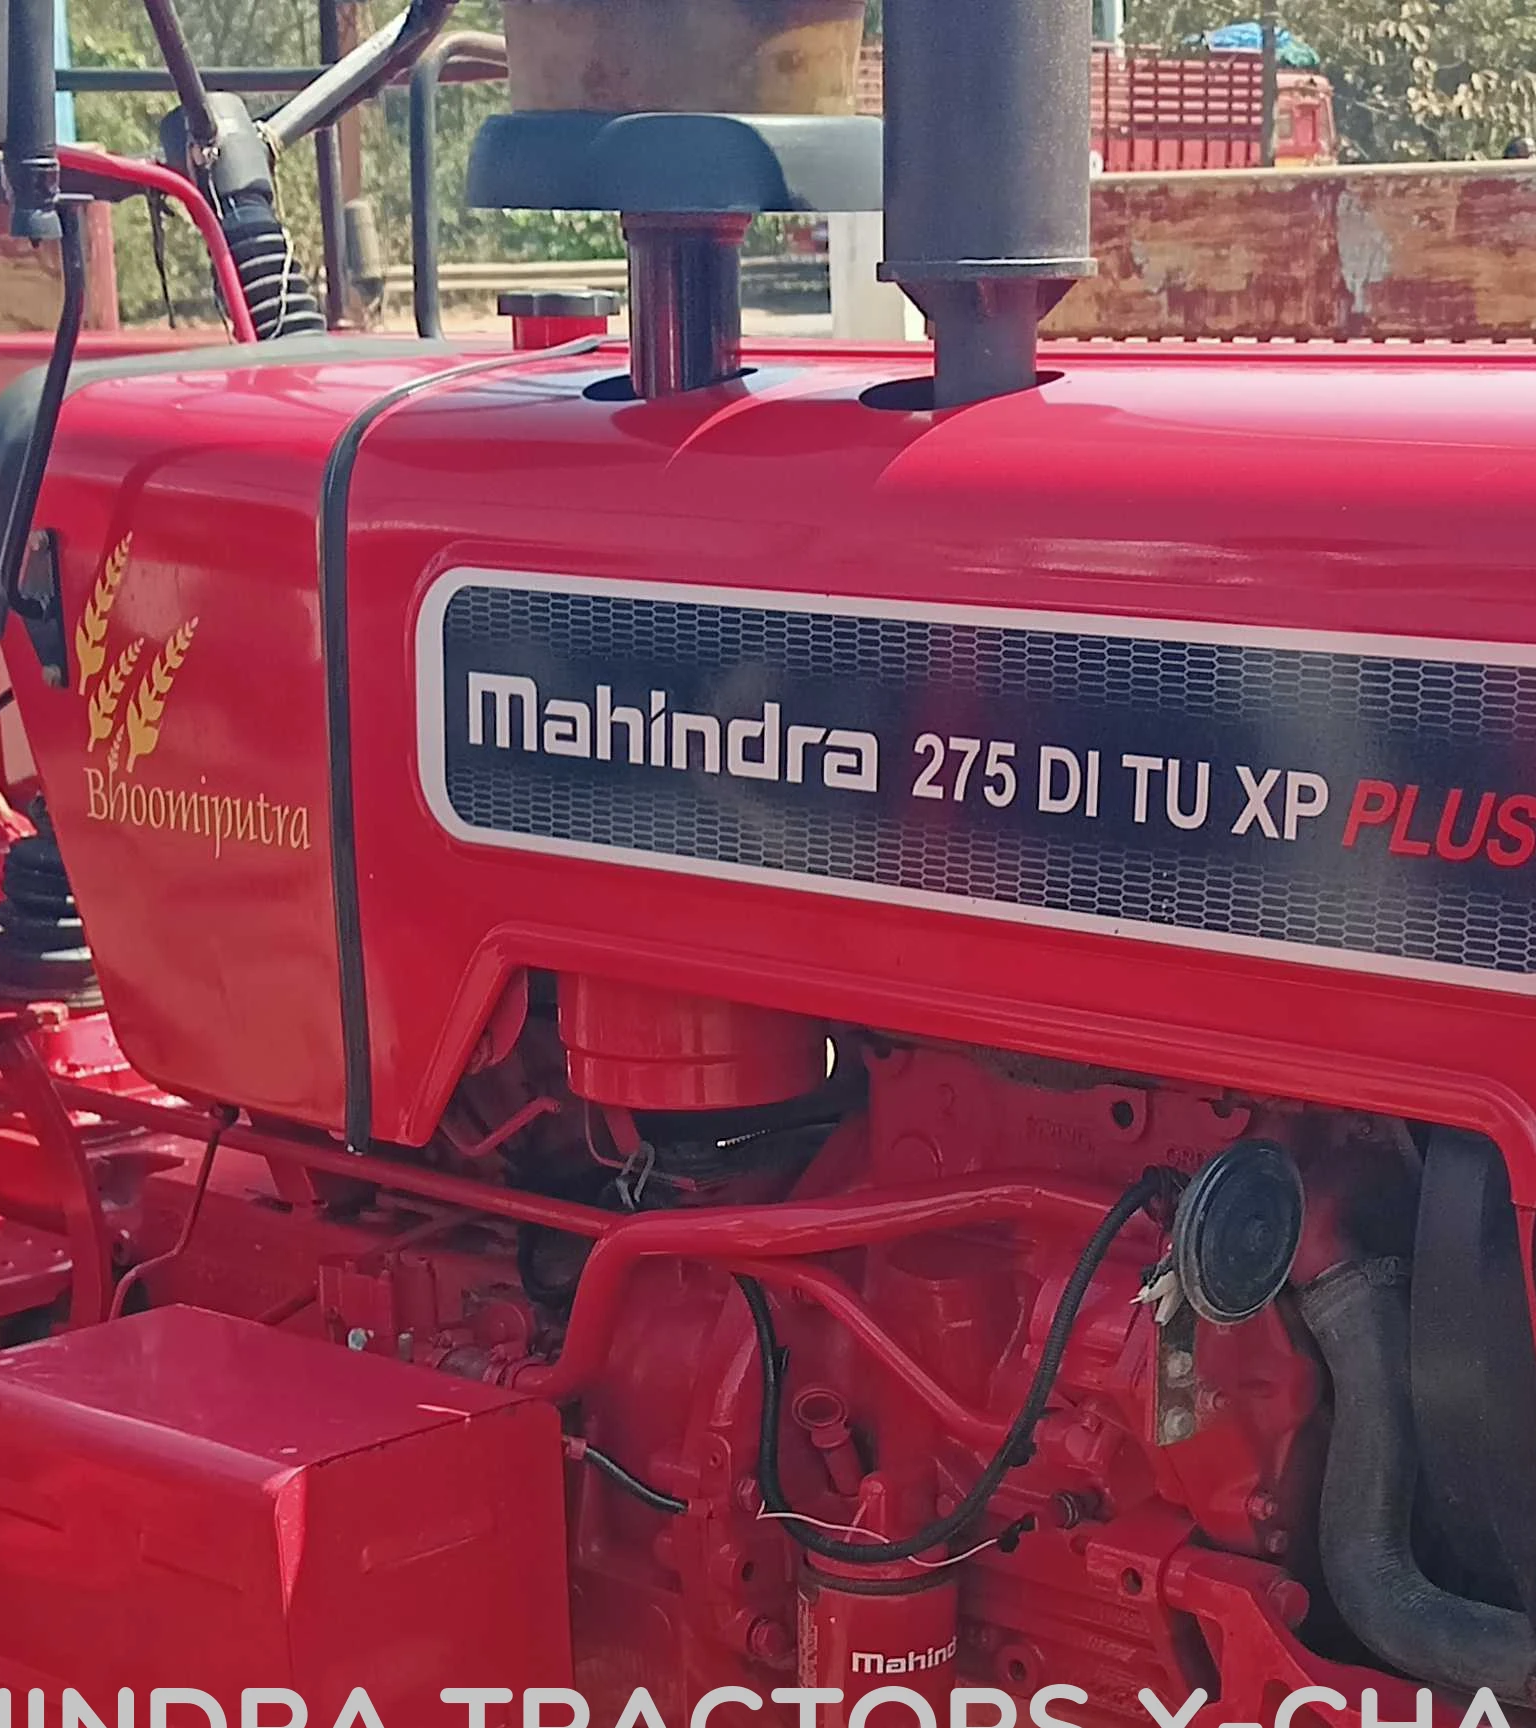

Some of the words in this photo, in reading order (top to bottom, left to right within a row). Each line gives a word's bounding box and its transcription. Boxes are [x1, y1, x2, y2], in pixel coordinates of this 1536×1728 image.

[85, 766, 311, 858] Bhoomiputra
[468, 670, 879, 792] Mahindra
[911, 731, 1018, 809] 275
[1037, 744, 1100, 818] DI
[1121, 753, 1211, 831] TU
[1230, 765, 1329, 842] XP
